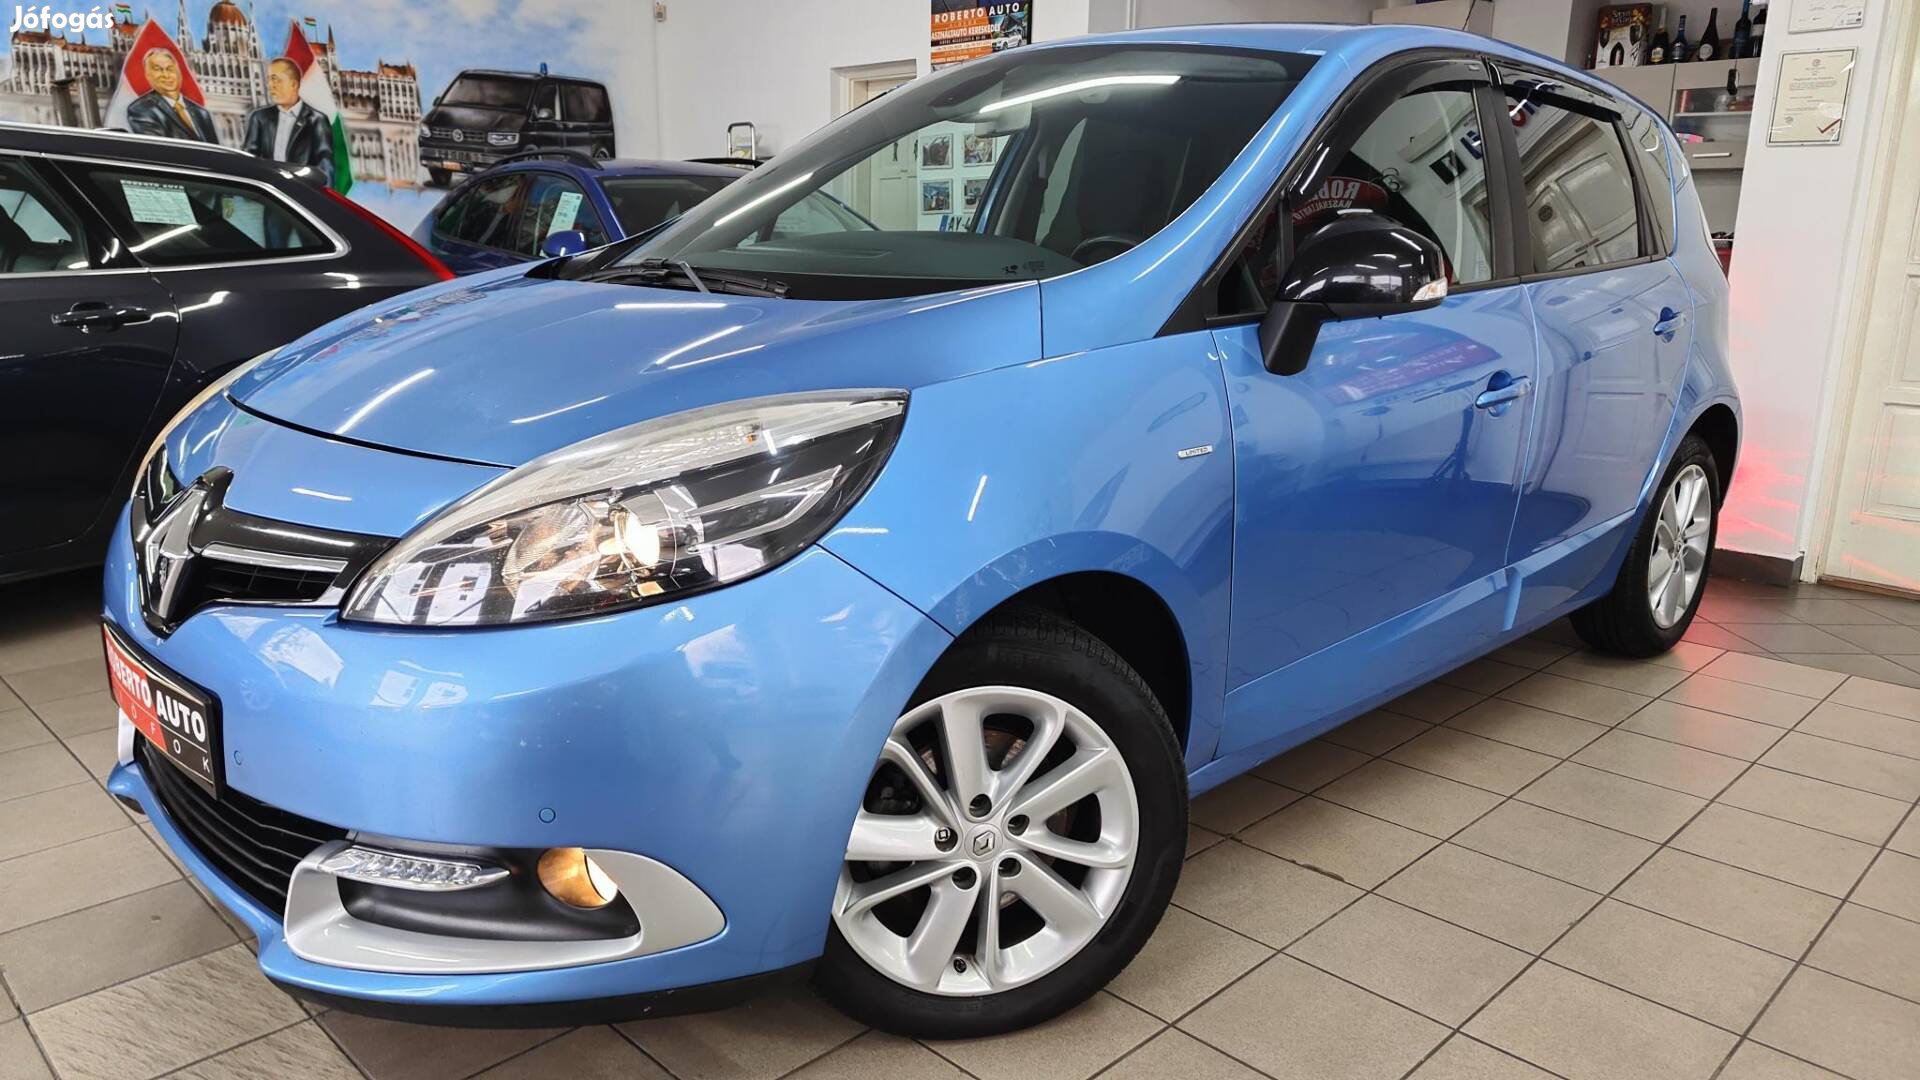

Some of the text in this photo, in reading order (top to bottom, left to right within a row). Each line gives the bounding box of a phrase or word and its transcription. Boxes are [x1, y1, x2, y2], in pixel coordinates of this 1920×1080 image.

[935, 2, 1020, 23] ROBERTO AUTO
[156, 689, 206, 742] AUTO
